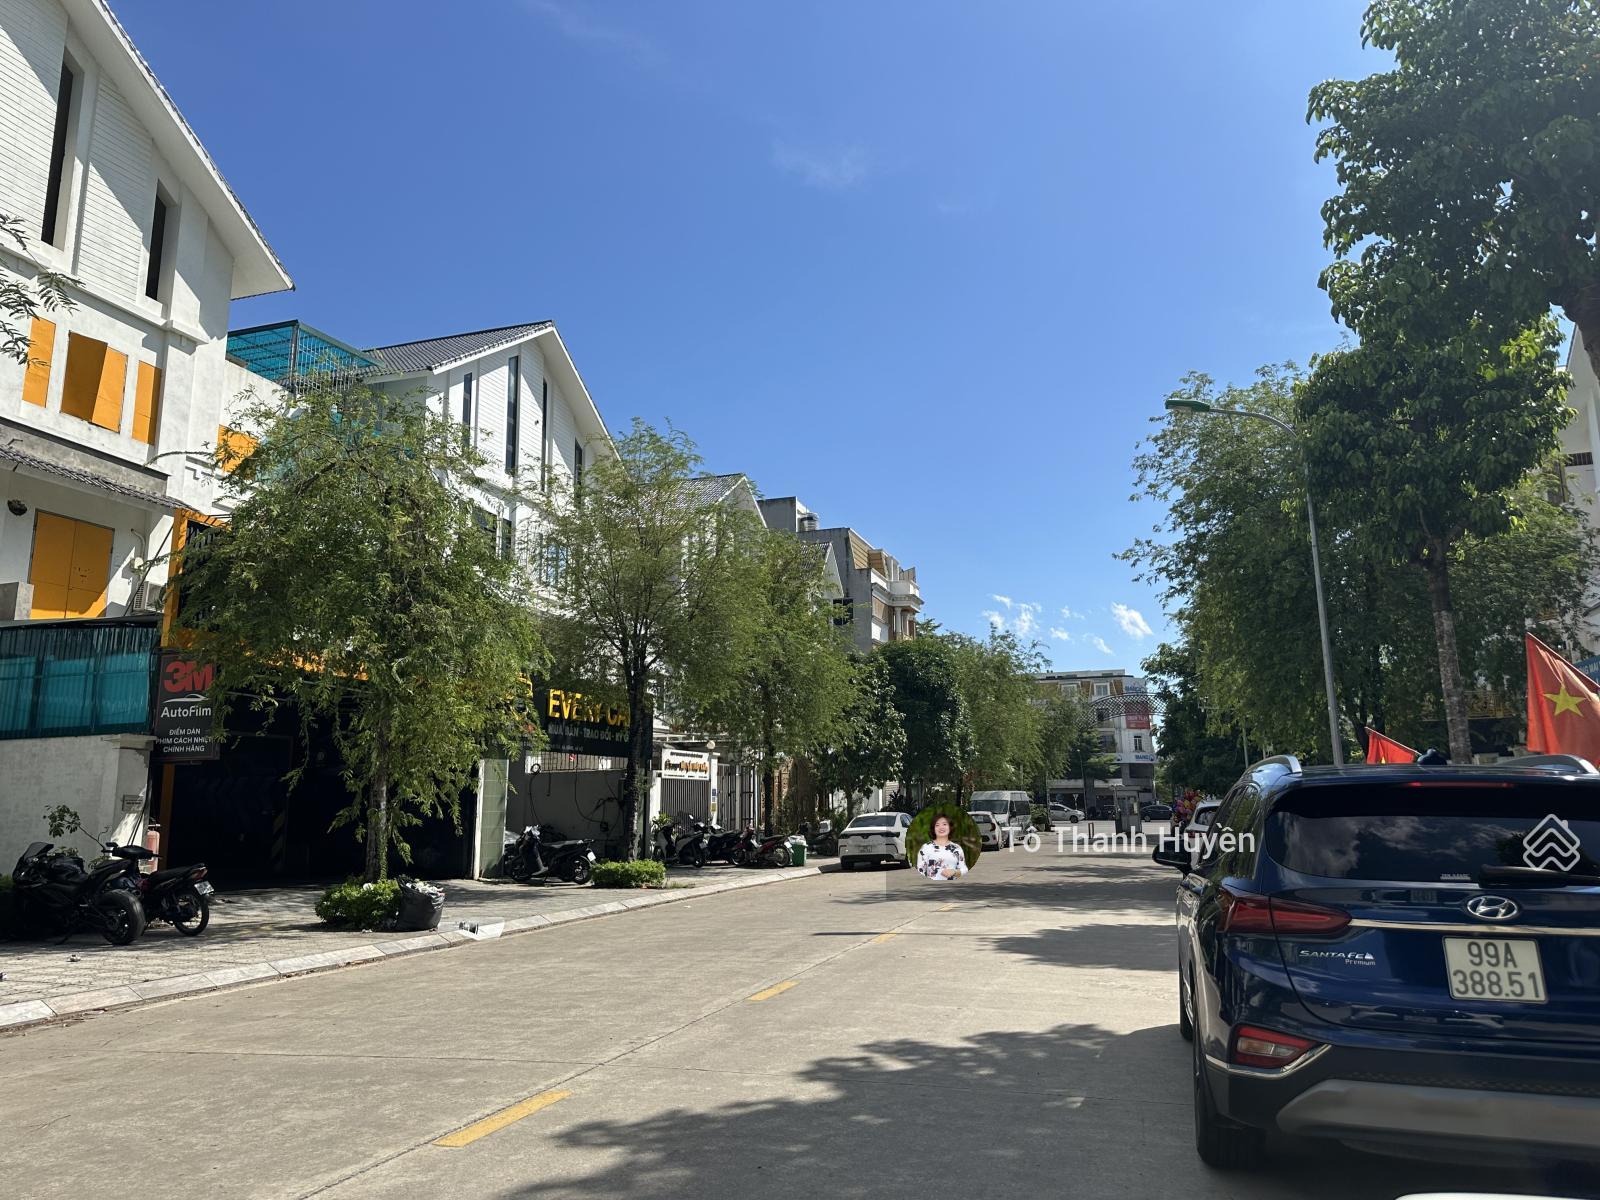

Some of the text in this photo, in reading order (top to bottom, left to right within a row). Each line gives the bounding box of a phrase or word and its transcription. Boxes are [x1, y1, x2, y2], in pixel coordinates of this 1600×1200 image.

[164, 660, 213, 693] 3M
[160, 705, 212, 718] AutoFilm
[1345, 958, 1376, 966] Premium
[1467, 941, 1518, 969] 99A
[1452, 970, 1541, 999] 388.51
